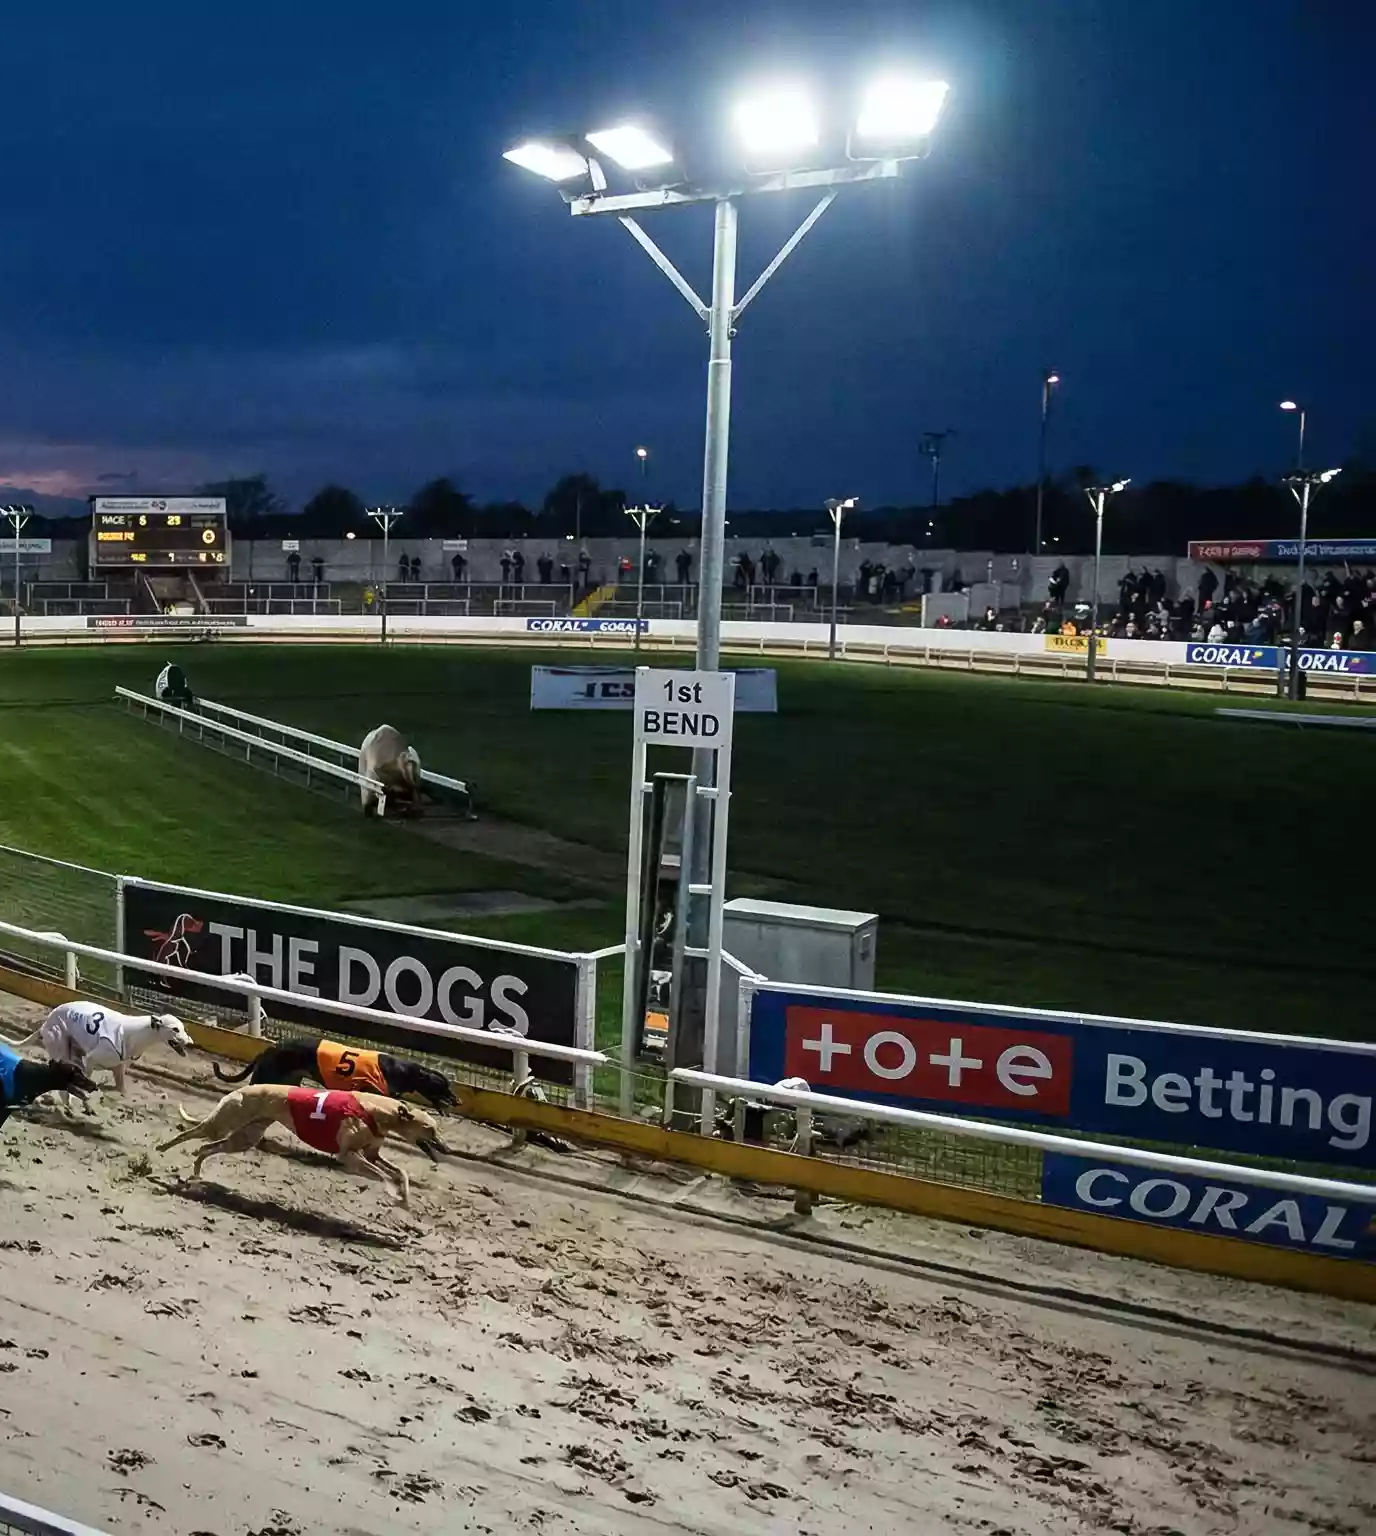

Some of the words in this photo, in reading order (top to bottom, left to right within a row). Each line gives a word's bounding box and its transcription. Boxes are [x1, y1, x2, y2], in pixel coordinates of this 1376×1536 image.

[530, 620, 581, 632] CORAL
[1191, 646, 1253, 665] CORAL
[663, 679, 703, 703] 1st
[643, 710, 720, 737] BEND
[209, 921, 320, 998] THE
[338, 945, 530, 1037] DOGS
[86, 1011, 105, 1035] 3
[335, 1050, 359, 1077] 5
[309, 1091, 330, 1120] 1
[1104, 1053, 1373, 1150] Betting
[1075, 1168, 1357, 1249] CORAL
